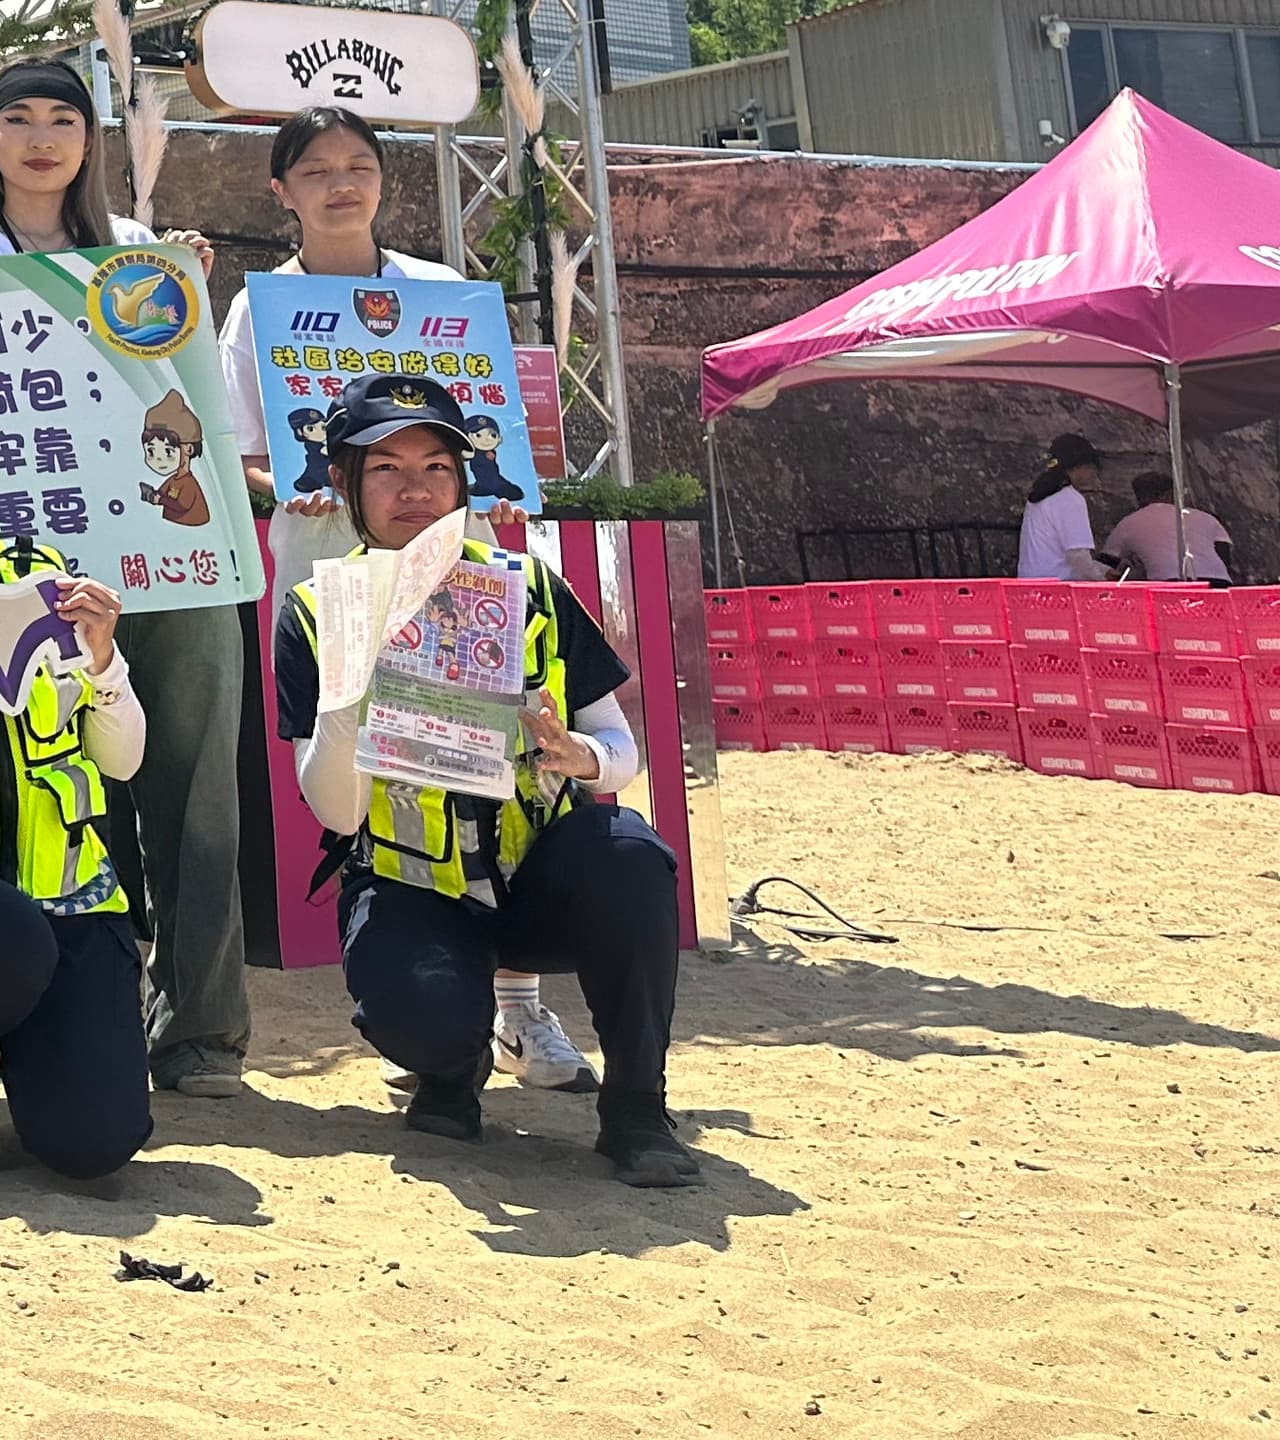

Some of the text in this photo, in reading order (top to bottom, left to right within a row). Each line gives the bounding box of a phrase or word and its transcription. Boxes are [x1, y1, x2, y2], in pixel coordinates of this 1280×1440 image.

[285, 38, 404, 96] BILLABONG
[290, 310, 341, 331] 110
[367, 318, 393, 330] POLICE
[420, 317, 469, 337] 113
[270, 345, 493, 379] 社區治安做得好
[121, 549, 240, 591] 關心您！
